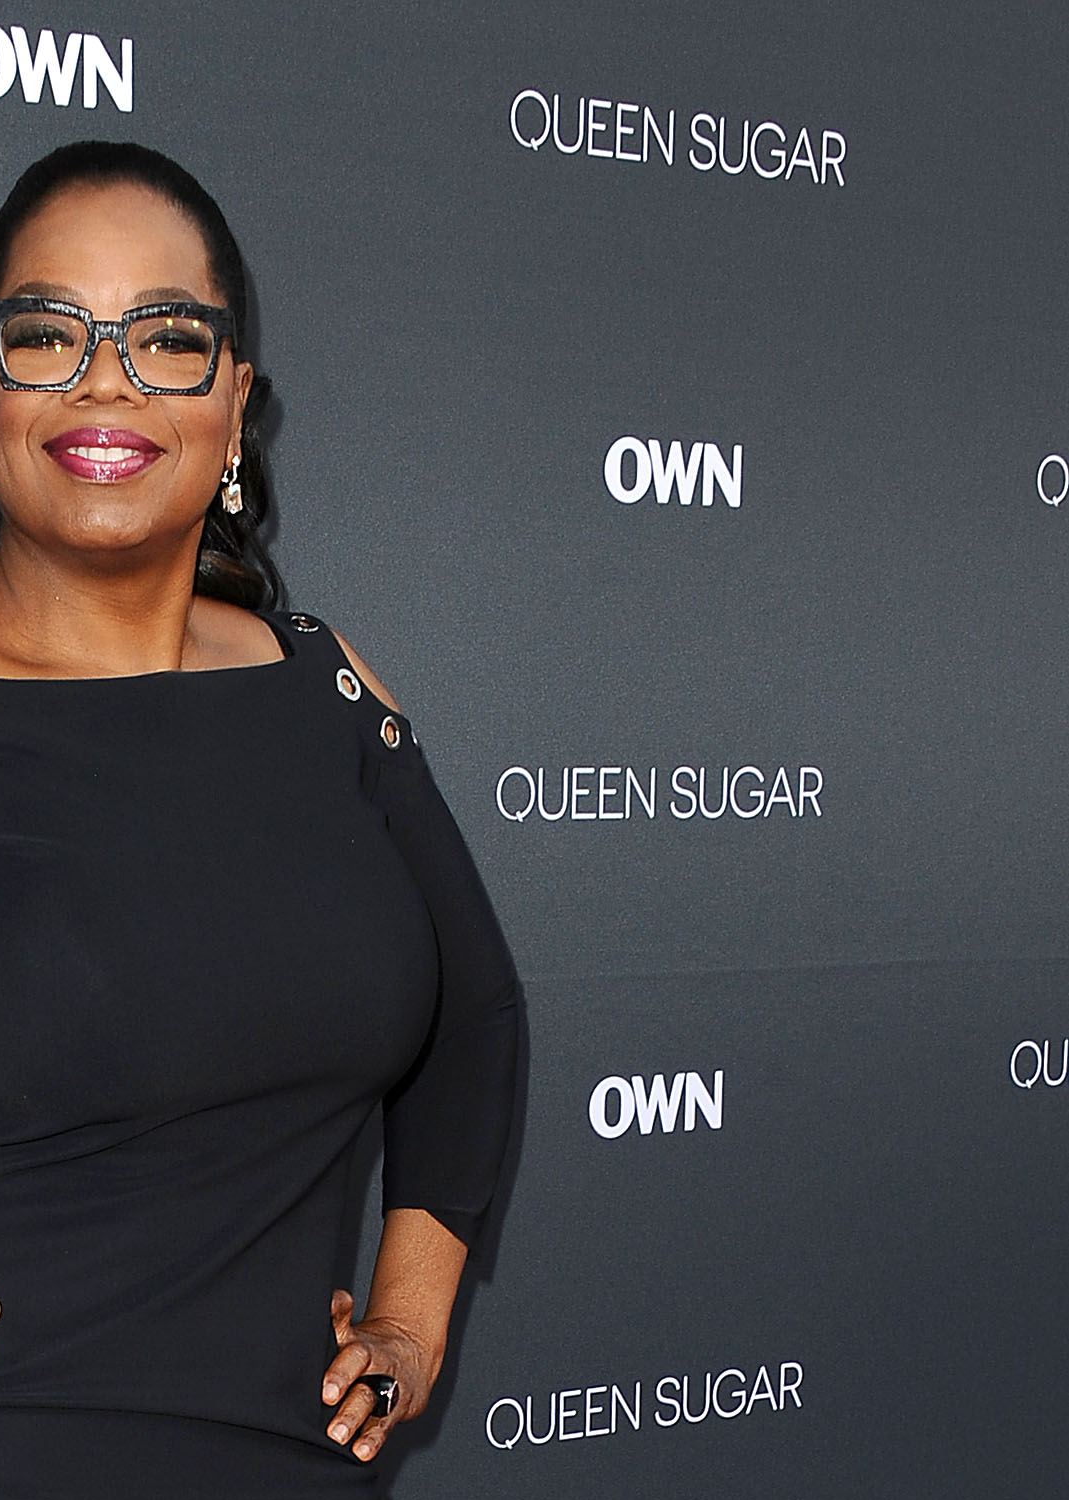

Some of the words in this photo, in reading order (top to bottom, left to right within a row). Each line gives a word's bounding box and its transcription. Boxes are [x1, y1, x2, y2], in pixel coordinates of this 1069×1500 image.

[510, 89, 675, 166] QUEEN
[689, 113, 846, 187] SUGAR
[604, 436, 743, 508] OWN
[496, 766, 656, 823] QUEEN
[670, 766, 823, 819] SUGAR
[588, 1070, 724, 1139] OWN
[486, 1381, 641, 1450] QUEEN
[654, 1362, 803, 1427] SUGAR
